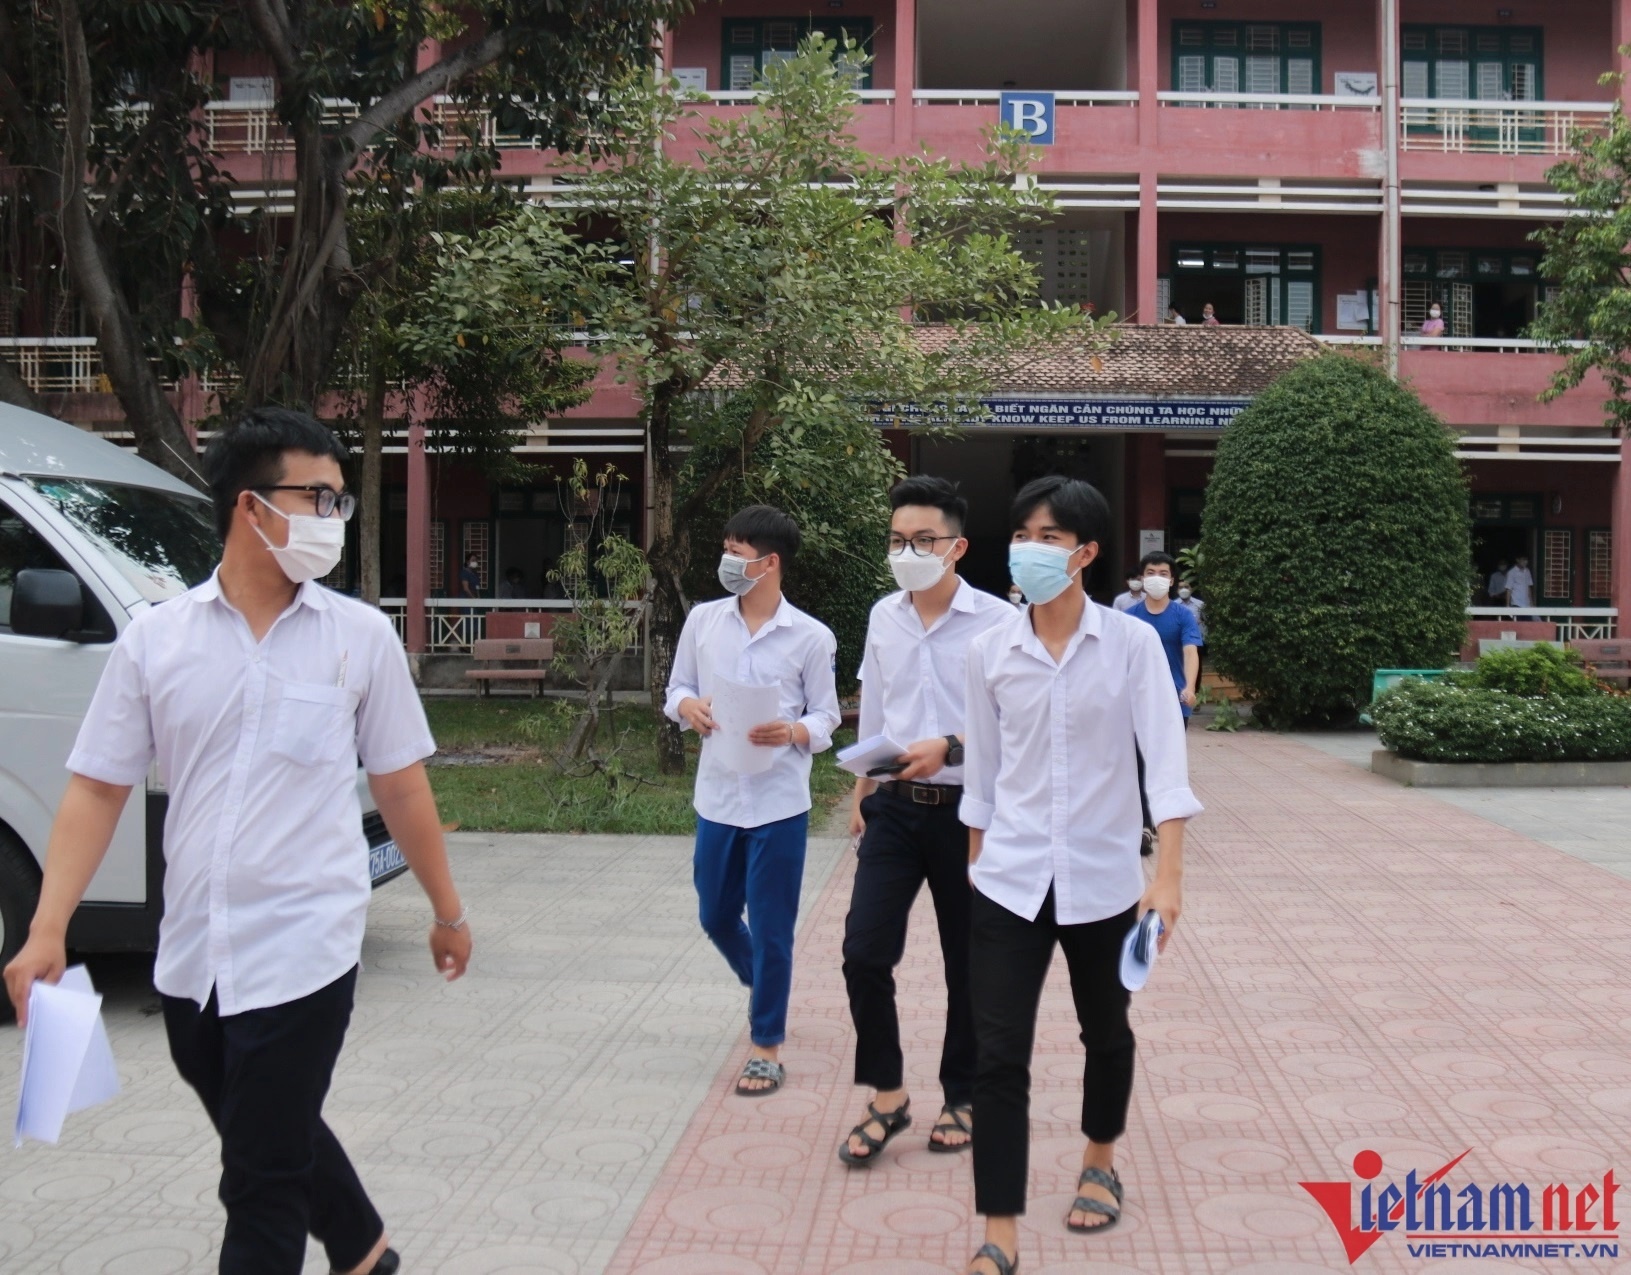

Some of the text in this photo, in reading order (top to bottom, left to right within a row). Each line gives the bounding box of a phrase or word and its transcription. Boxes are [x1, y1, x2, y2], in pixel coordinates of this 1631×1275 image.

[1008, 100, 1048, 136] B
[995, 402, 1026, 413] BIẾT
[1106, 405, 1154, 415] CHÚNG
[1158, 406, 1174, 415] TA
[1177, 406, 1206, 417] HỌC
[991, 415, 1035, 423] KNOW
[1039, 415, 1075, 424] KEEP
[1079, 416, 1098, 424] US
[1101, 416, 1141, 425] FROM
[1145, 416, 1214, 425] LEARNING
